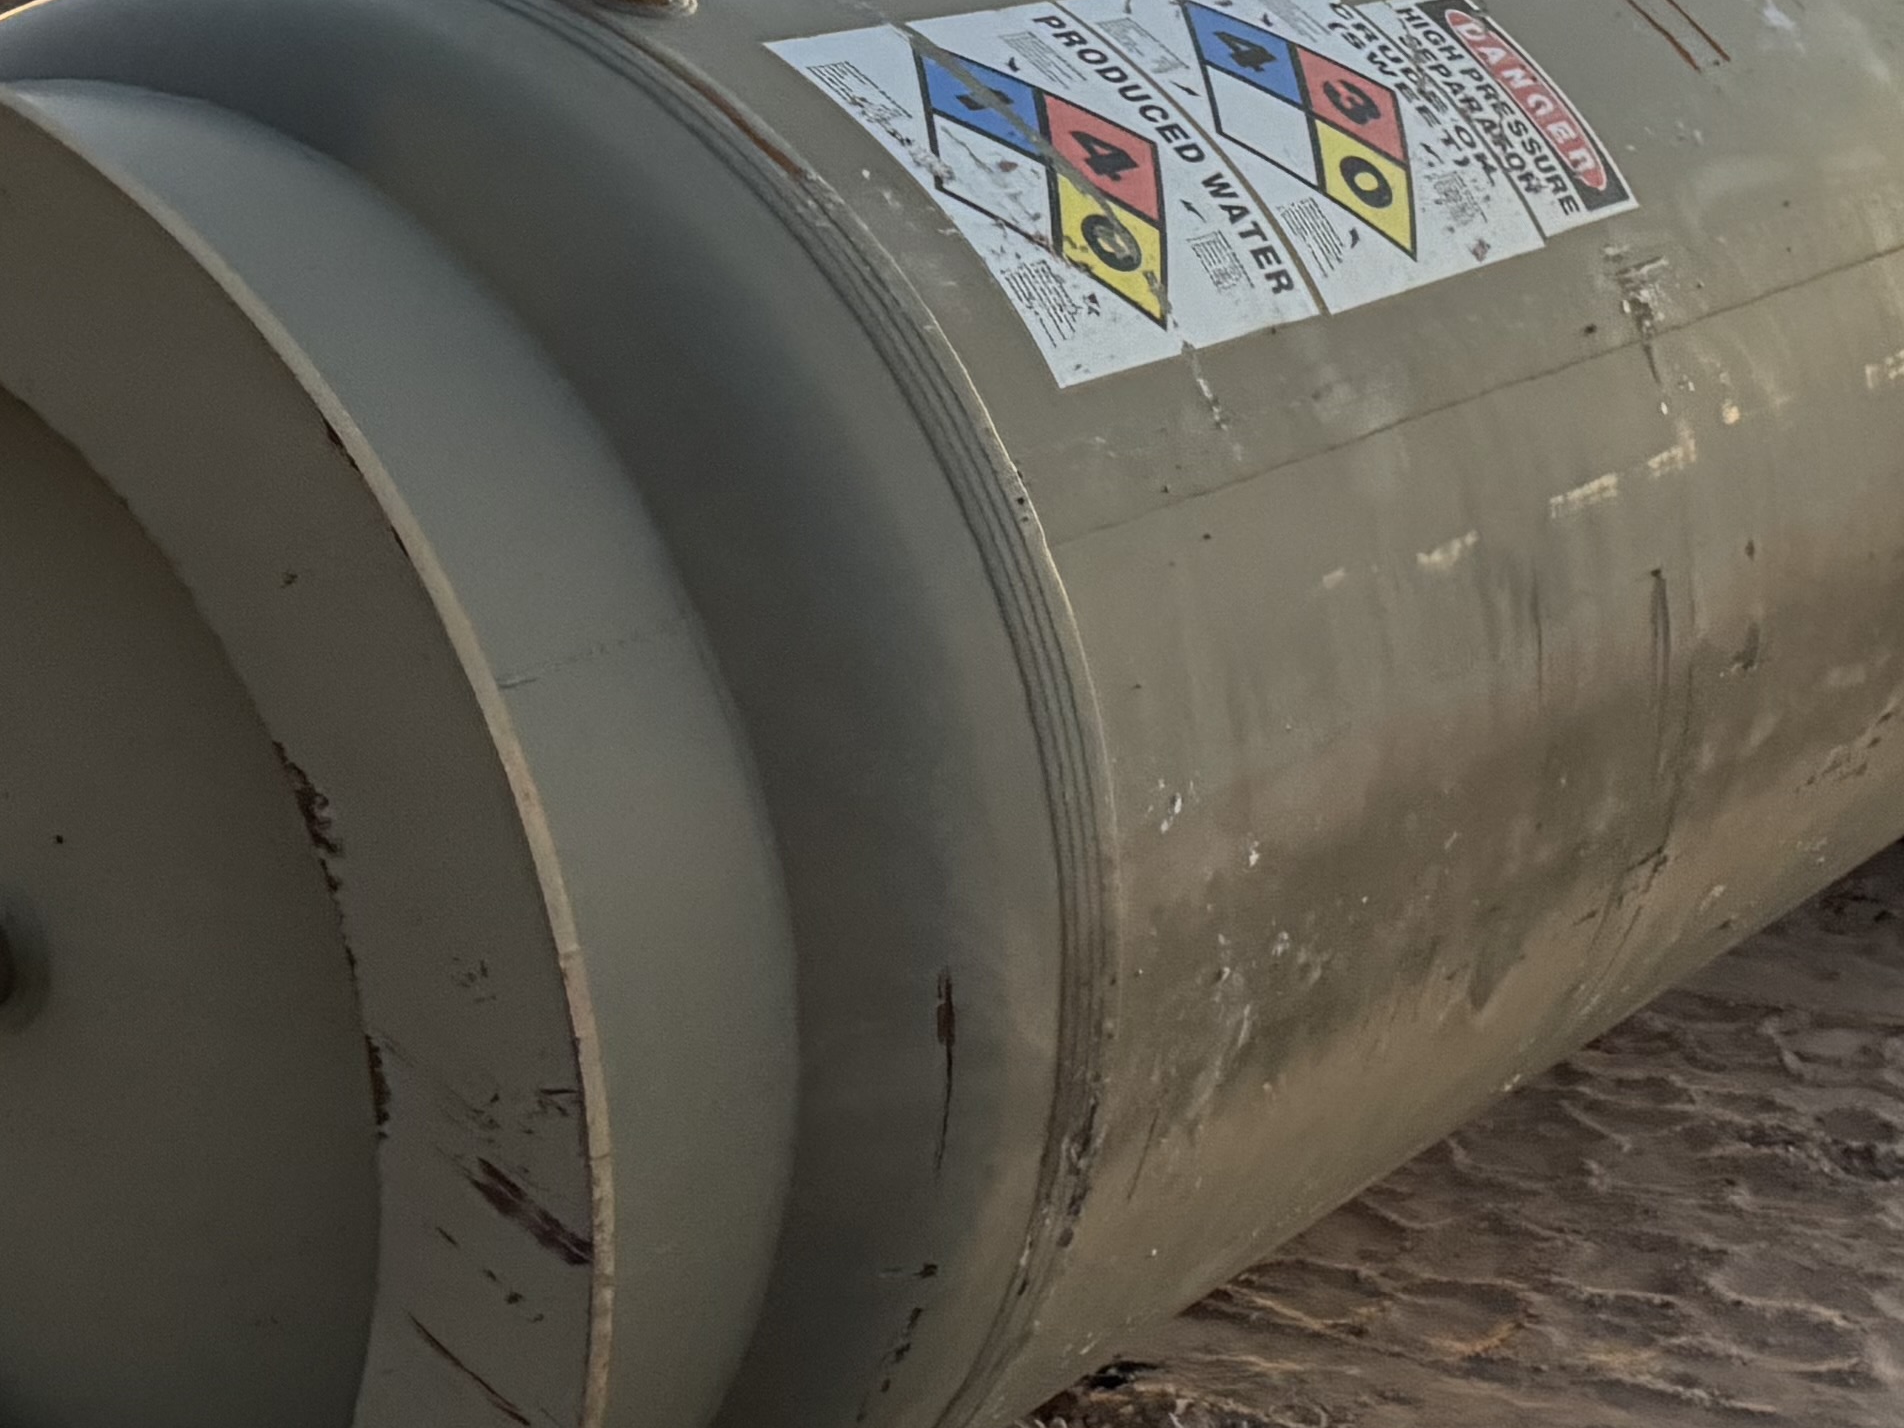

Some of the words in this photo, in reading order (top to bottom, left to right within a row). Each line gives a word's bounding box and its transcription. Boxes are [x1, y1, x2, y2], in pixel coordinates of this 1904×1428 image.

[1213, 30, 1277, 72] 4
[1322, 78, 1382, 125] 3
[1327, 22, 1471, 167] (SWEET)
[1396, 6, 1464, 61] HIGH
[1458, 66, 1581, 216] PRESSURE
[1456, 22, 1599, 172] DANGER
[1033, 14, 1206, 164] PRODUCED
[1201, 171, 1295, 295] WATER
[1069, 129, 1139, 181] 4
[1339, 155, 1393, 208] 0
[1080, 212, 1143, 272] 0
